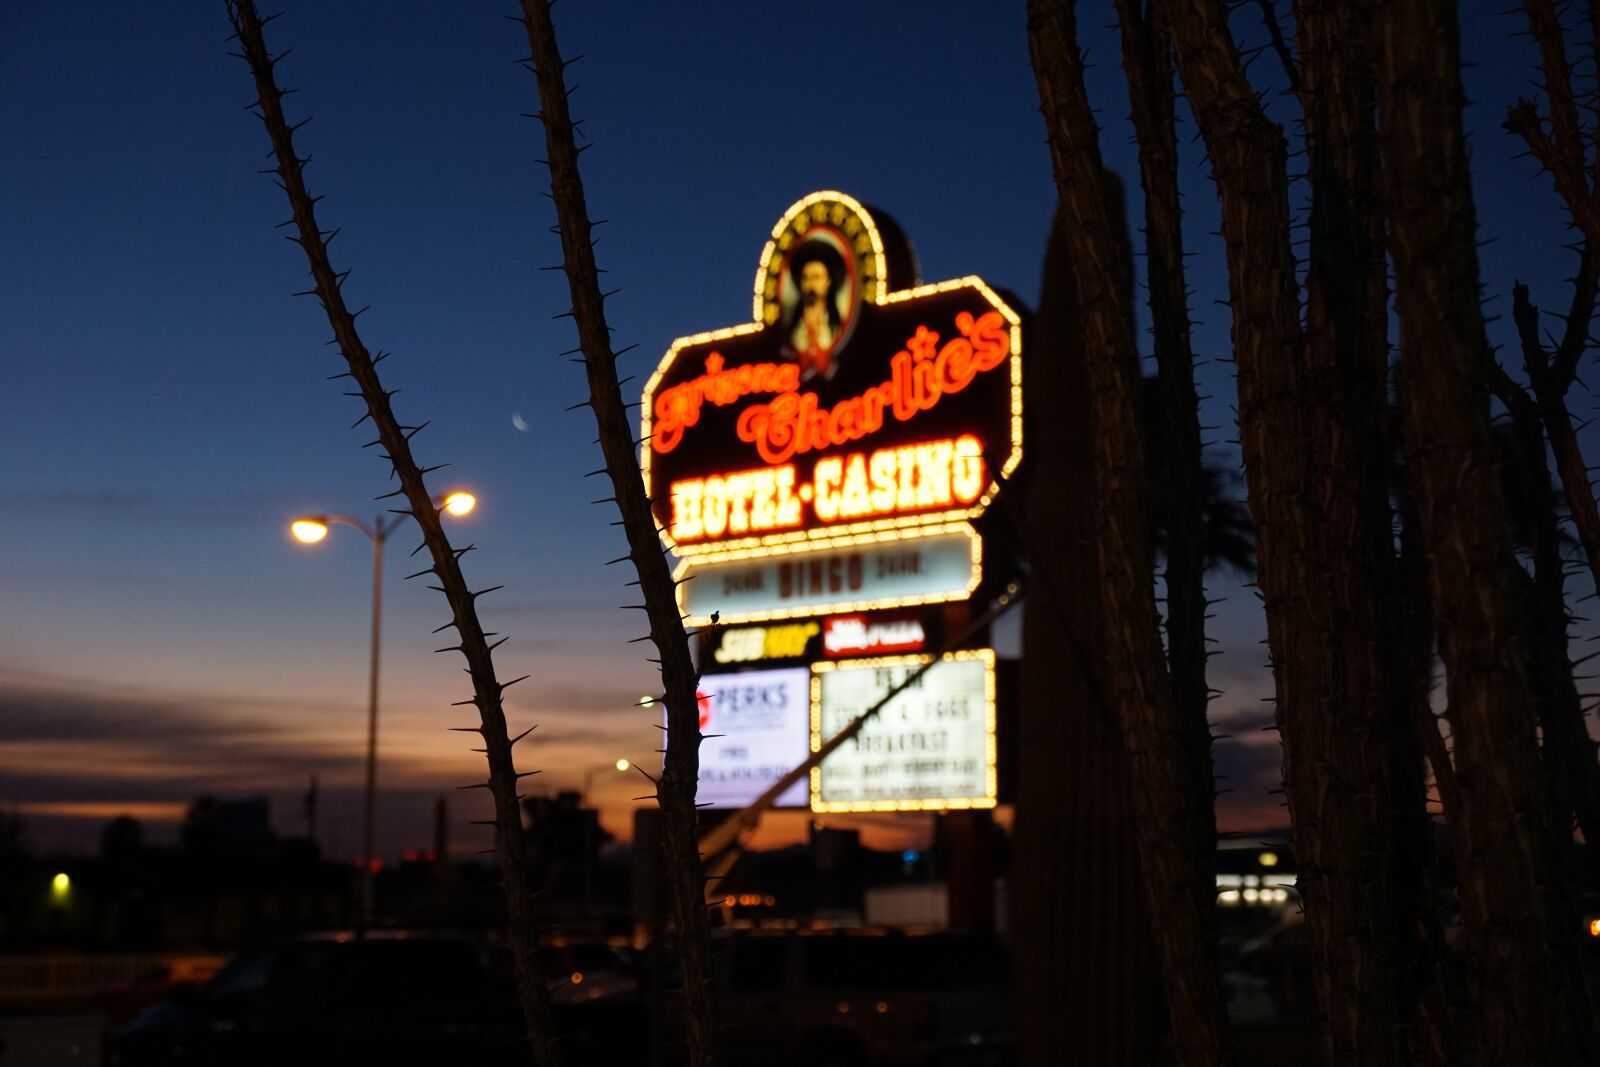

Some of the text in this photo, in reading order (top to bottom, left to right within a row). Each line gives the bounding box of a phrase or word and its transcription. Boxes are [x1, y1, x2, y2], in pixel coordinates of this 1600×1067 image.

[736, 312, 1011, 464] Charlie's
[778, 552, 864, 600] BINGO
[714, 681, 789, 712] PERKS
